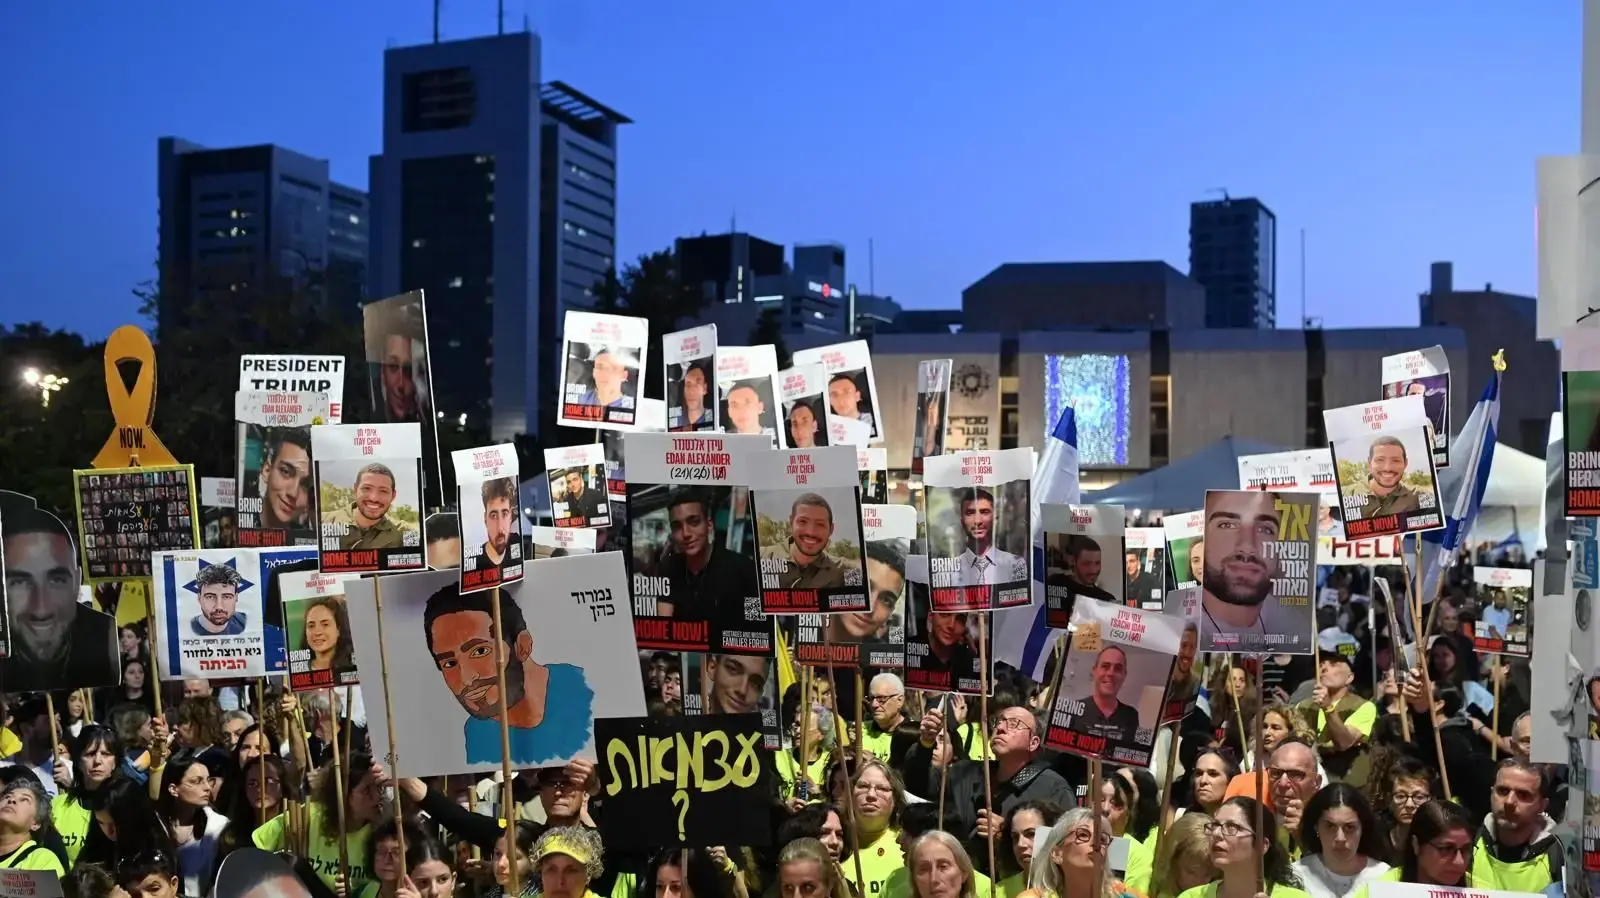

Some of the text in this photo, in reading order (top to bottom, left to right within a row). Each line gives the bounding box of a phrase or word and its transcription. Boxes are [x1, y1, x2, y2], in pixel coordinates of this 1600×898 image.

[243, 359, 343, 373] PRESIDENT
[250, 378, 332, 393] TRUMP
[564, 403, 584, 416] HOME
[120, 427, 146, 449] NOW.
[367, 437, 381, 446] CHEN
[671, 439, 723, 453] עידן אלכסנדר
[665, 451, 731, 466] EDAN ALEXANDER
[800, 463, 815, 474] CHEN
[1568, 469, 1592, 488] HER
[238, 498, 263, 513] BRING
[1342, 494, 1369, 508] BRING
[238, 513, 255, 529] HIM
[863, 518, 882, 528] ANDER
[1274, 498, 1312, 542] אל
[1345, 507, 1362, 522] HIM
[321, 523, 350, 538] BRING
[1347, 514, 1400, 536] HOME NOW!
[239, 529, 288, 547] HOME NOW!
[322, 536, 341, 551] HIM
[322, 550, 379, 567] HOME NOW!
[464, 544, 483, 559] BRING
[1262, 541, 1309, 560] תשאירו
[464, 558, 477, 571] HIM
[760, 558, 789, 575] BRING
[931, 557, 960, 573] BRING
[1280, 560, 1309, 578] אותי
[463, 567, 501, 587] HOME NOW!
[761, 573, 780, 589] HIM
[932, 572, 952, 589] HIM
[633, 576, 671, 597] BRING
[1269, 579, 1309, 597] מאחור
[571, 587, 612, 605] נמרוד
[764, 590, 819, 607] HOME NOW!
[933, 588, 961, 605] HOME
[963, 587, 990, 604] NOW!
[590, 603, 615, 622] כהן
[634, 596, 657, 617] HIM
[634, 618, 709, 642] HOME NOW!
[1110, 617, 1147, 635] TSACHI IDAN
[722, 637, 769, 649] FAMILIES FORUM
[798, 627, 819, 643] HIM
[183, 648, 262, 660] גיא רוצה לחזור
[289, 649, 311, 662] BRING
[798, 644, 860, 663] HOME NOW!
[906, 642, 929, 657] BRING
[199, 658, 247, 671] הביתה
[906, 655, 921, 668] HIM
[291, 672, 312, 688] HOME
[312, 668, 334, 685] NOW!
[684, 694, 705, 709] BRI
[1054, 698, 1086, 717] BRING
[1051, 710, 1072, 729] HIM
[1047, 727, 1078, 747] HOME
[1077, 733, 1107, 753] NOW!
[606, 730, 762, 797] עצמאות
[671, 788, 690, 842] ?
